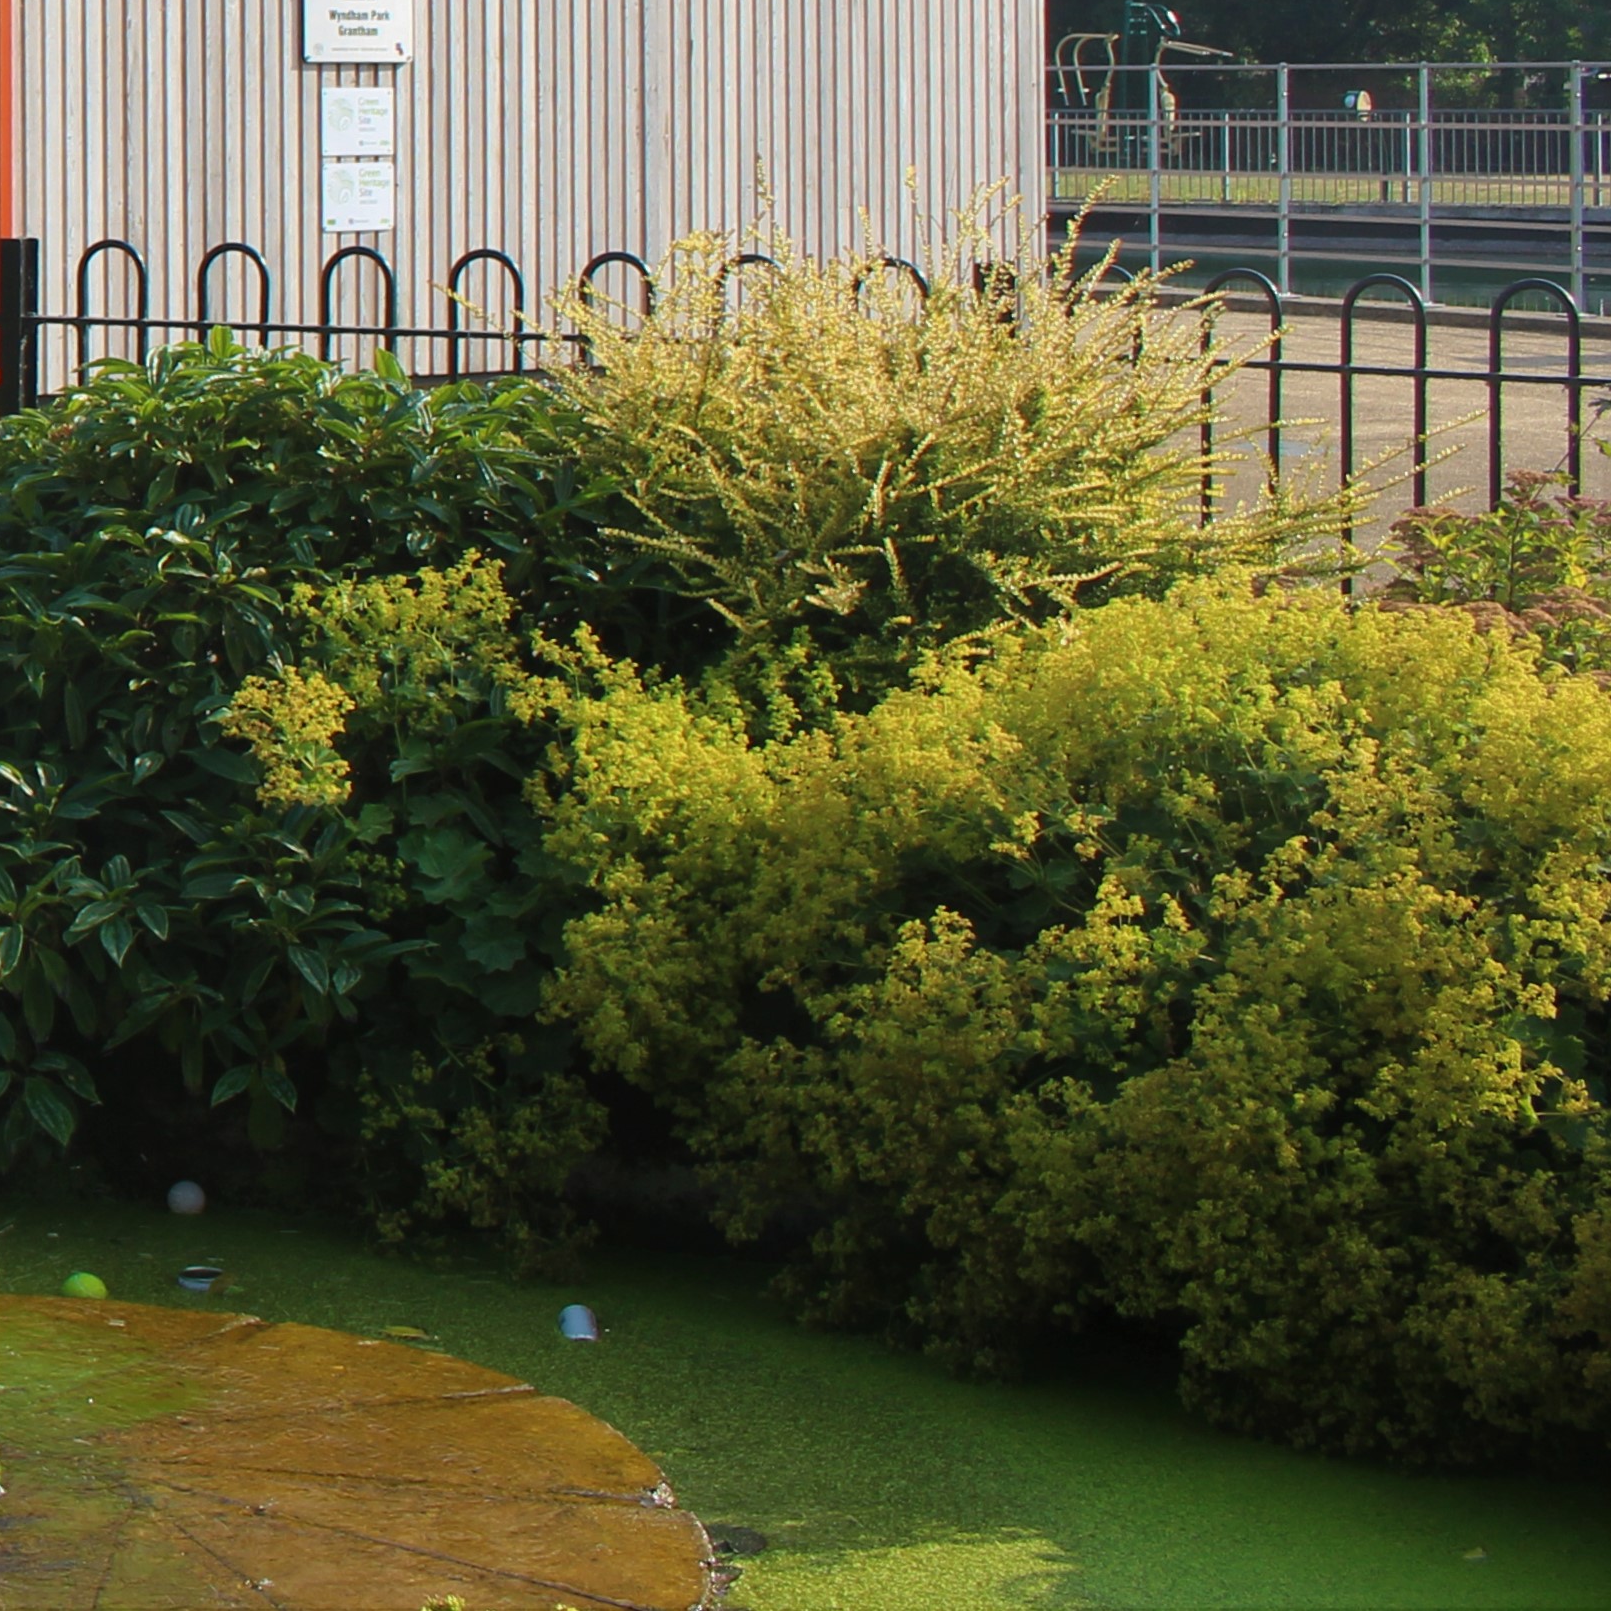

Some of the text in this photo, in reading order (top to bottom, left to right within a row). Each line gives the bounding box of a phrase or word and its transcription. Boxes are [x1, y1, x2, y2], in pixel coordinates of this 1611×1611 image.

[328, 8, 390, 23] Wyndham Park
[338, 24, 378, 37] Grantham
[358, 96, 379, 106] Green
[358, 107, 389, 117] Heritage
[358, 168, 381, 178] Green
[358, 179, 391, 189] Heritage
[358, 188, 373, 197] Site
